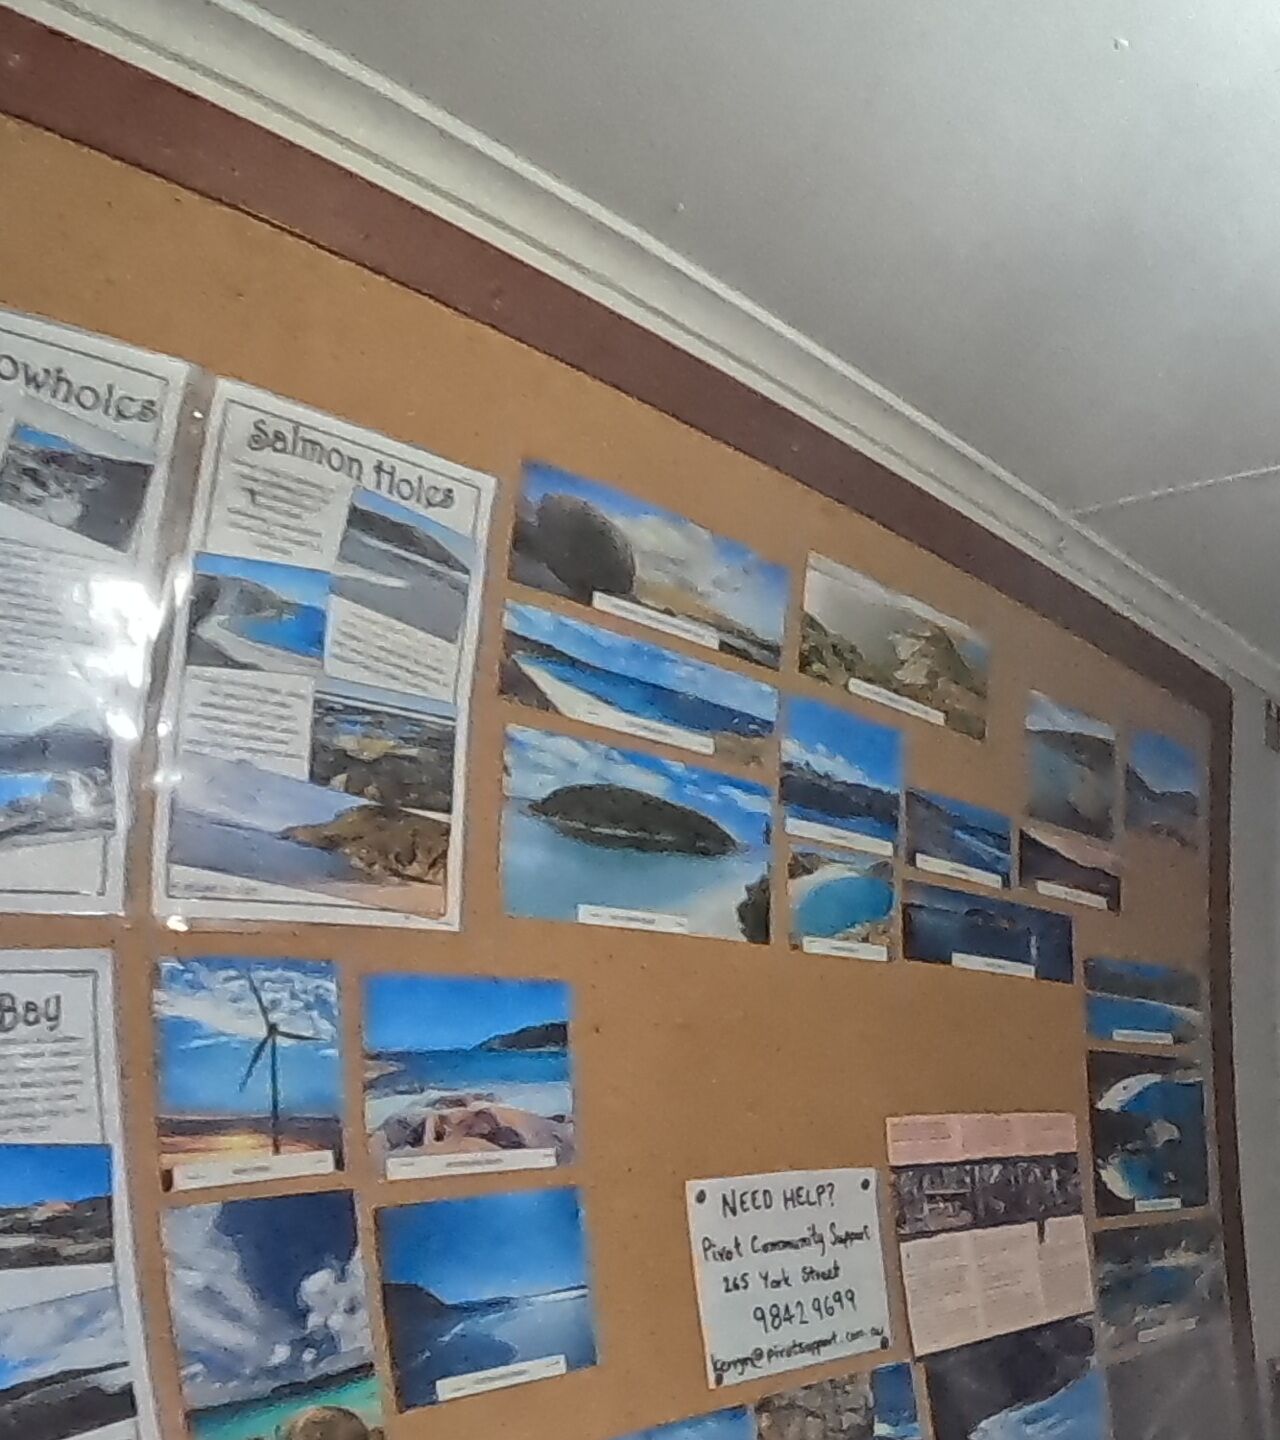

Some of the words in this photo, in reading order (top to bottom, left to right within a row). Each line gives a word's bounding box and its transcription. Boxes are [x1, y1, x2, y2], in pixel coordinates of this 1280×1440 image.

[248, 418, 364, 482] Salmon
[372, 458, 455, 510] Holes
[722, 1188, 774, 1219] NEED
[783, 1182, 835, 1210] HELP?
[702, 1235, 742, 1262] Pivot
[750, 1223, 826, 1257] Community
[722, 1271, 750, 1293] 265
[758, 1266, 793, 1290] York
[801, 1258, 841, 1284] Street
